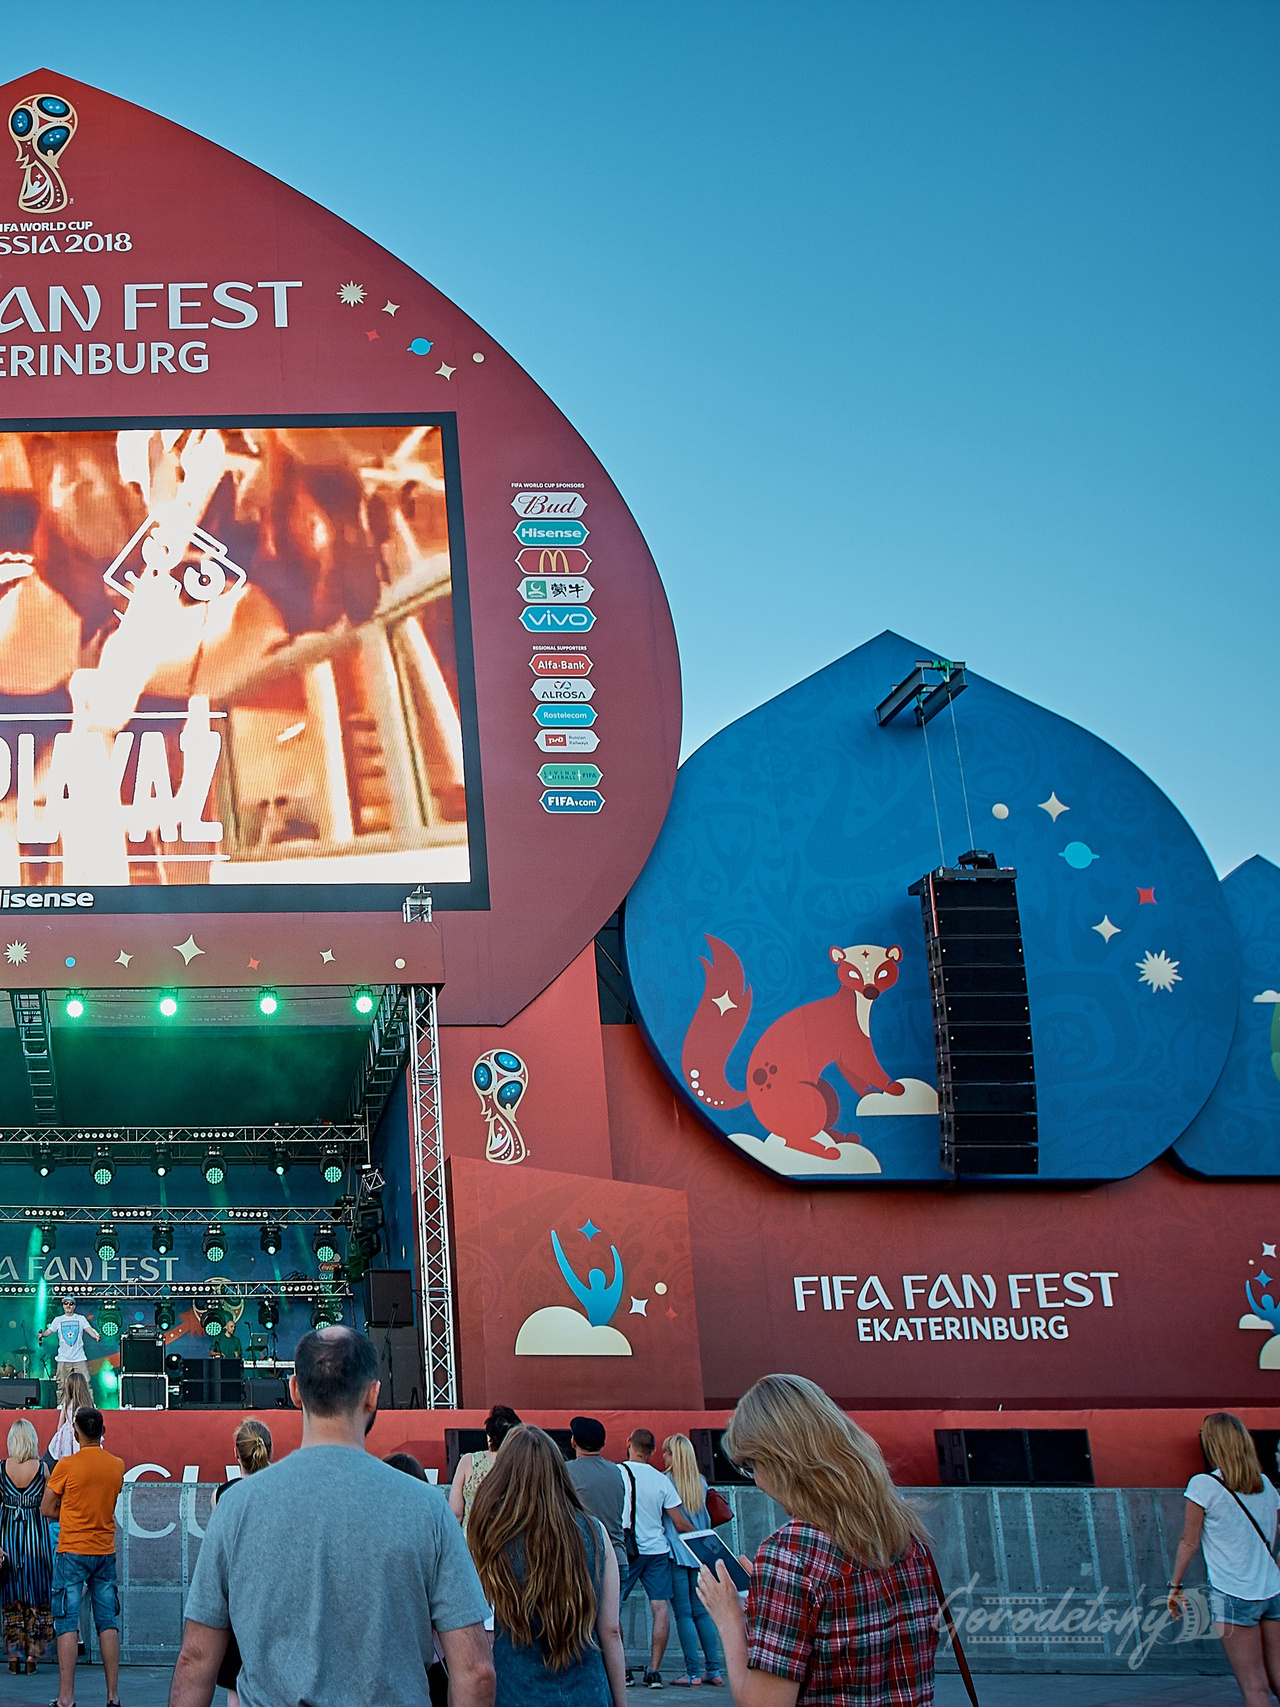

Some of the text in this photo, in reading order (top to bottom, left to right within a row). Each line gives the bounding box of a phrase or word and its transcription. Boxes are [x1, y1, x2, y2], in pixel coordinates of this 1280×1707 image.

[20, 221, 66, 232] WORLD
[67, 221, 93, 230] CUP
[64, 232, 133, 253] 2018
[123, 281, 303, 330] FEST
[518, 495, 578, 515] Bud
[521, 528, 582, 538] Hisense
[528, 609, 588, 626] vivo
[541, 691, 587, 699] ALROSA
[543, 711, 588, 720] Rostelecom
[28, 1256, 94, 1281] FAN
[101, 1256, 180, 1282] FEST
[793, 1271, 1119, 1312] FIFA FAN FEST
[856, 1315, 1070, 1342] EKATERINBURG
